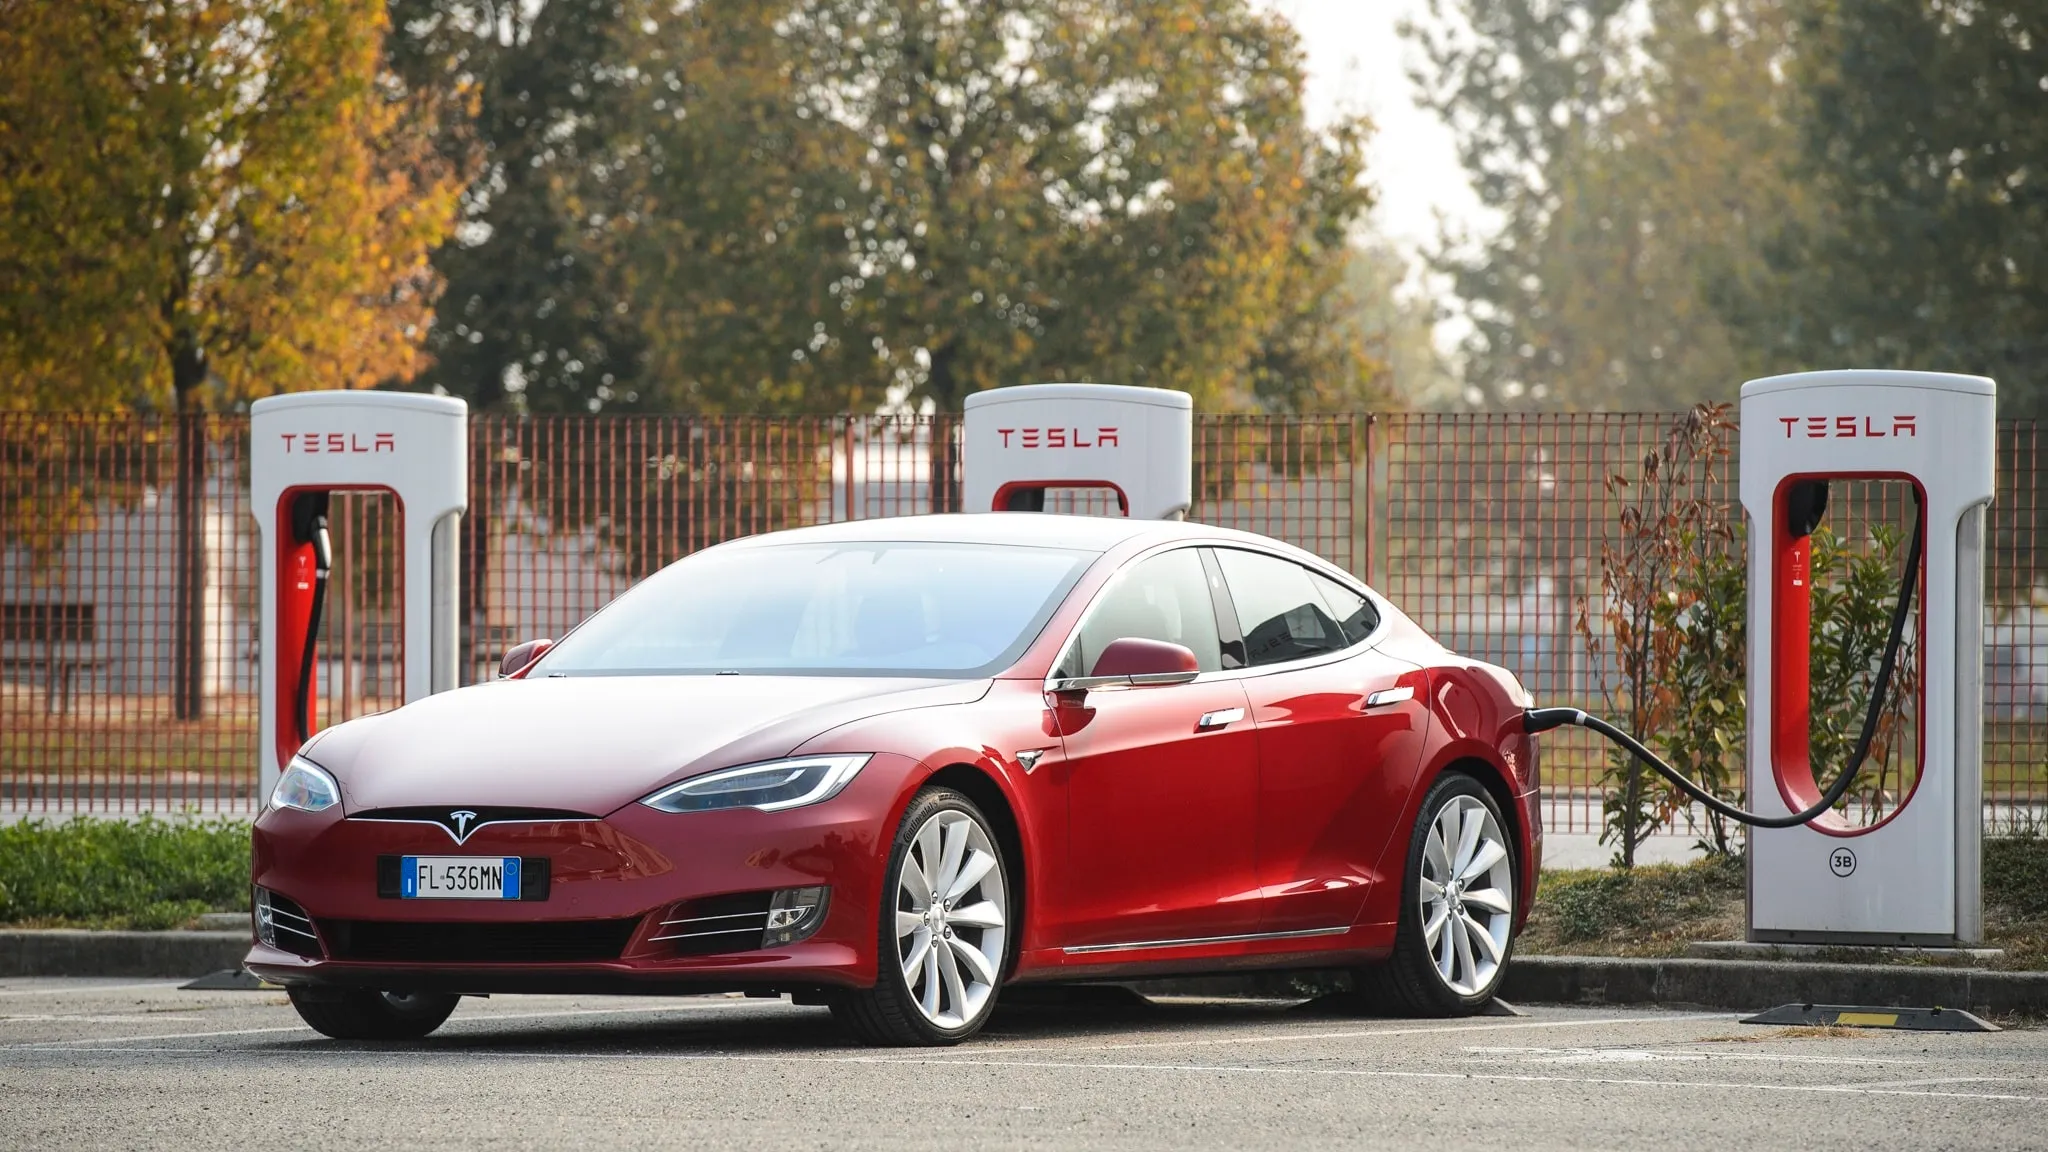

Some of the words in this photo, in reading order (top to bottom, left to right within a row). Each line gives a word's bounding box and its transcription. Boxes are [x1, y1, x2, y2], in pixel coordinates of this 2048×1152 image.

[1779, 415, 1916, 438] TESLA
[281, 433, 395, 453] TESLA
[998, 427, 1119, 449] TESLA
[903, 802, 935, 843] Continental
[1834, 856, 1852, 868] 3B
